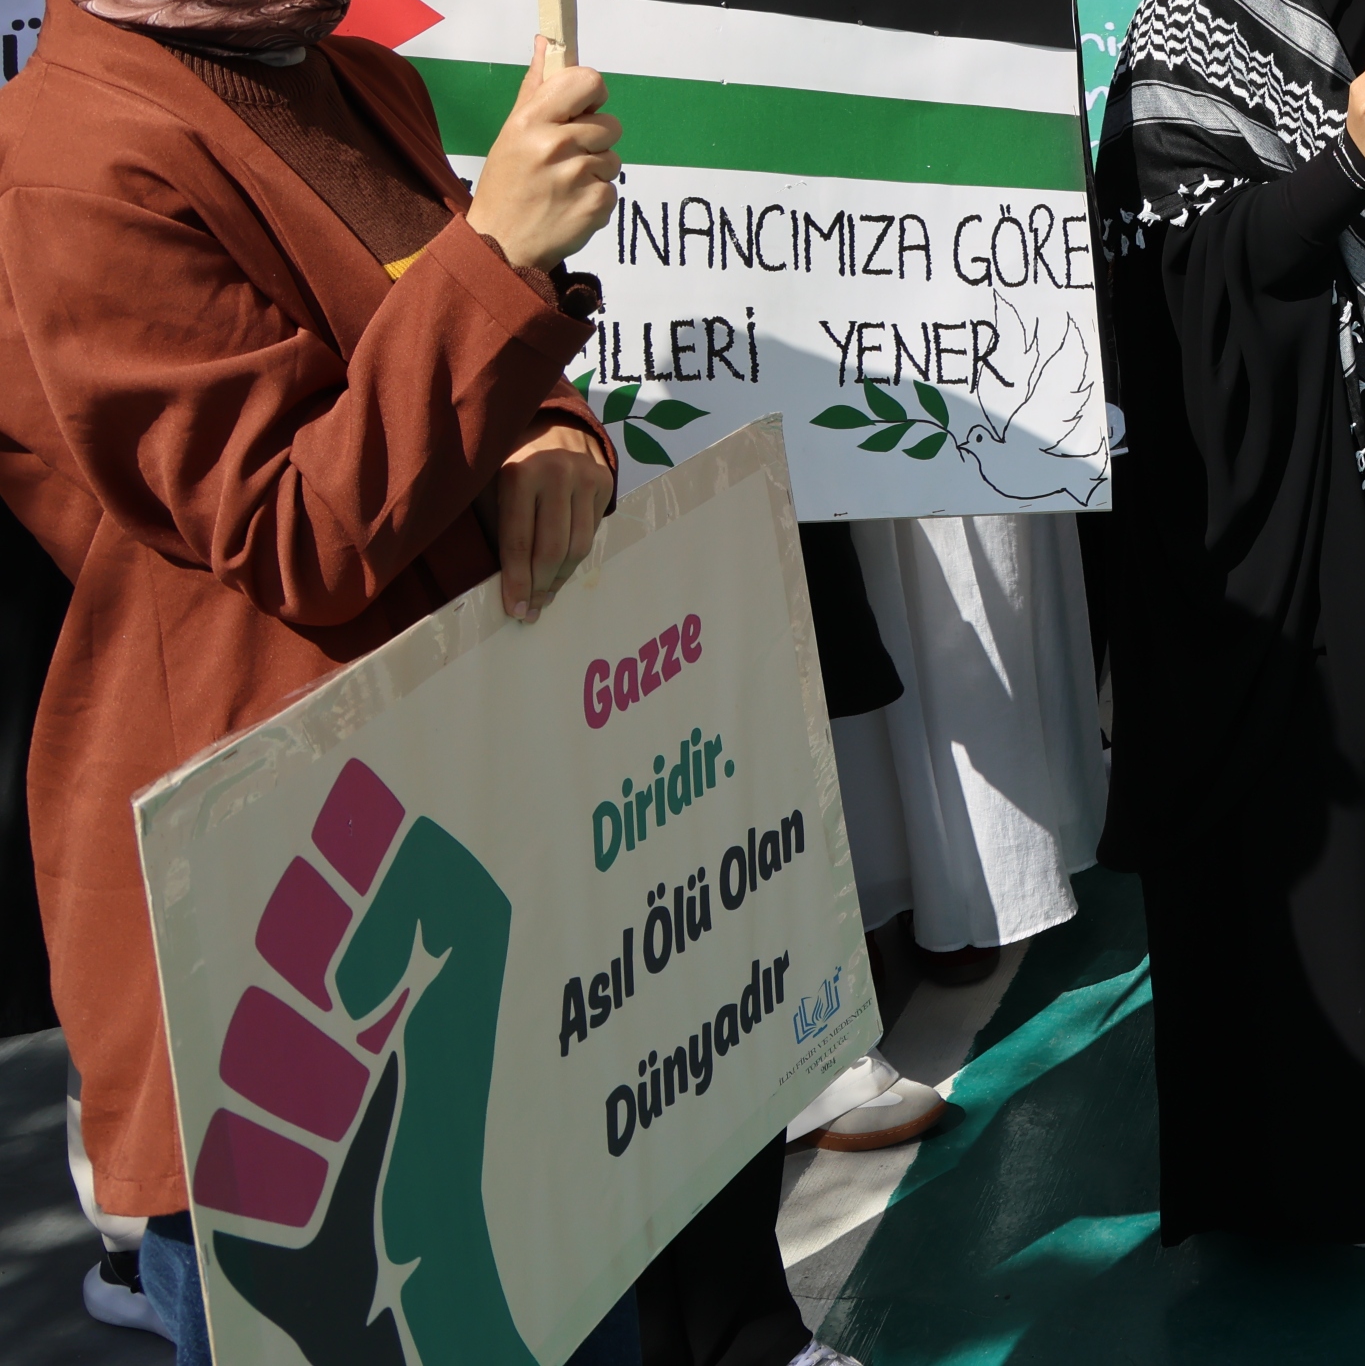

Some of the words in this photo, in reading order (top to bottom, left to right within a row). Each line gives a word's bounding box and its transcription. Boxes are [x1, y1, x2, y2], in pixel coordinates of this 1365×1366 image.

[617, 171, 932, 283] İNANCIMIZA
[953, 203, 1095, 291] GÖRE
[819, 316, 1015, 389] YENER
[582, 612, 703, 730] Gazze
[592, 726, 738, 873] Diridir.
[558, 936, 635, 1058] Asıl
[642, 866, 713, 977] Ölü
[718, 808, 806, 915] Olan
[604, 947, 792, 1158] Dünyadır
